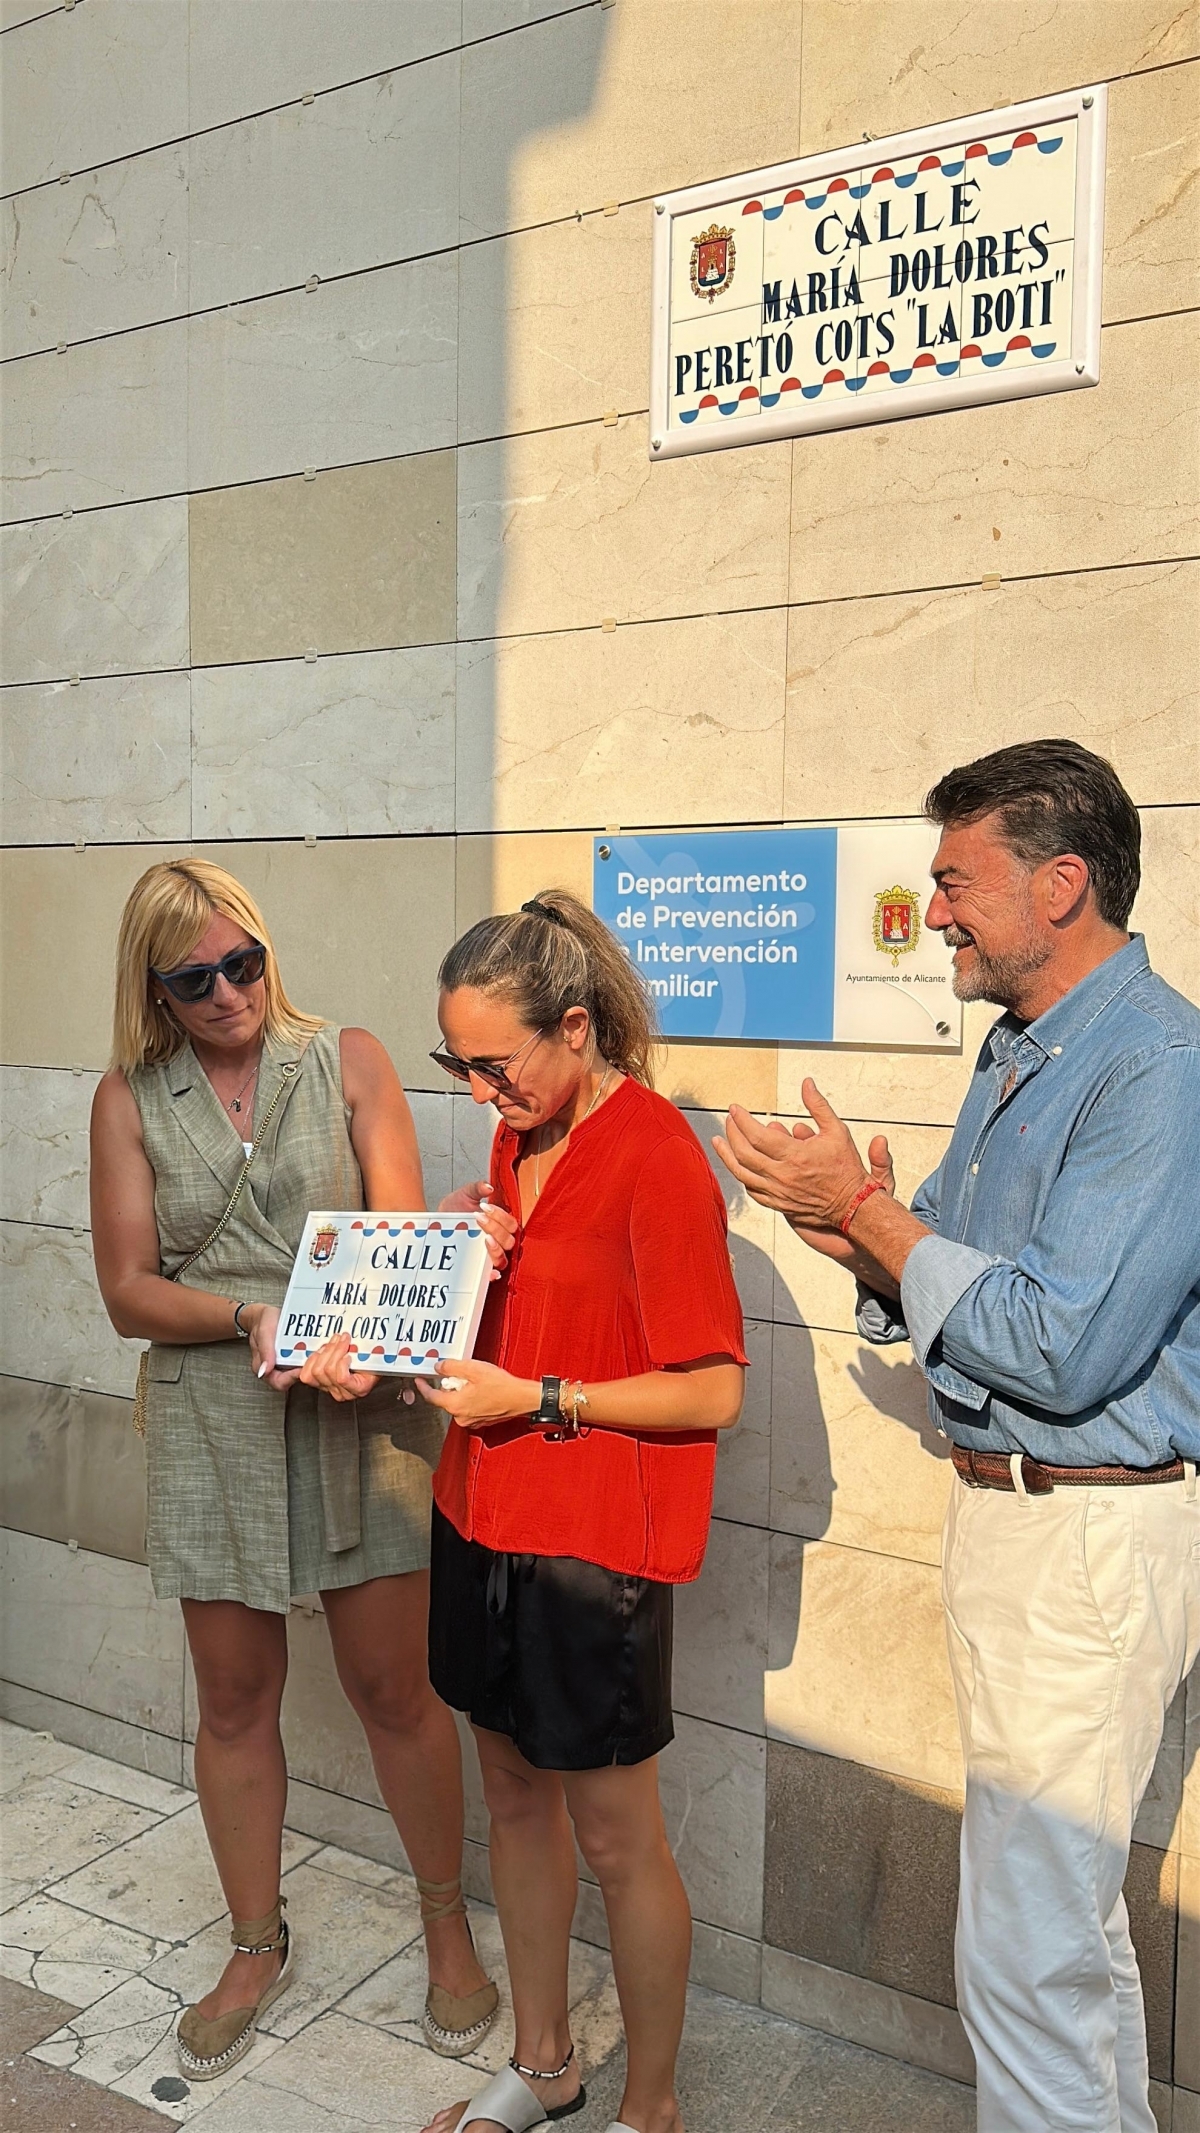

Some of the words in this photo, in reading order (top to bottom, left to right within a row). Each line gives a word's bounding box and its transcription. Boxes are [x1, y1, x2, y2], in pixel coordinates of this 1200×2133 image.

[814, 178, 983, 256] CALLE
[762, 255, 864, 325] MARÍA
[889, 221, 1050, 299] DOLORES
[674, 321, 794, 397] PERETÓ
[815, 309, 896, 366] COTS
[907, 297, 961, 349] "LA
[970, 269, 1066, 339] BOTI"
[617, 870, 807, 900] Departamento
[616, 906, 647, 929] de
[653, 904, 798, 929] Prevención
[884, 909, 891, 917] A
[903, 909, 909, 917] L
[884, 922, 889, 930] L
[902, 922, 909, 930] A
[637, 940, 798, 964] Intervención
[640, 974, 719, 998] miliar
[845, 973, 901, 985] Ayuntamiento
[901, 974, 912, 983] de
[913, 974, 947, 984] Alicante
[371, 1243, 458, 1271] CALLE
[321, 1277, 368, 1306] MARÍA
[378, 1282, 450, 1309] DOLORES
[284, 1310, 347, 1338] PERETÓ
[351, 1316, 390, 1341] COTS
[394, 1313, 414, 1343] "LA
[419, 1316, 464, 1344] BOTI"
